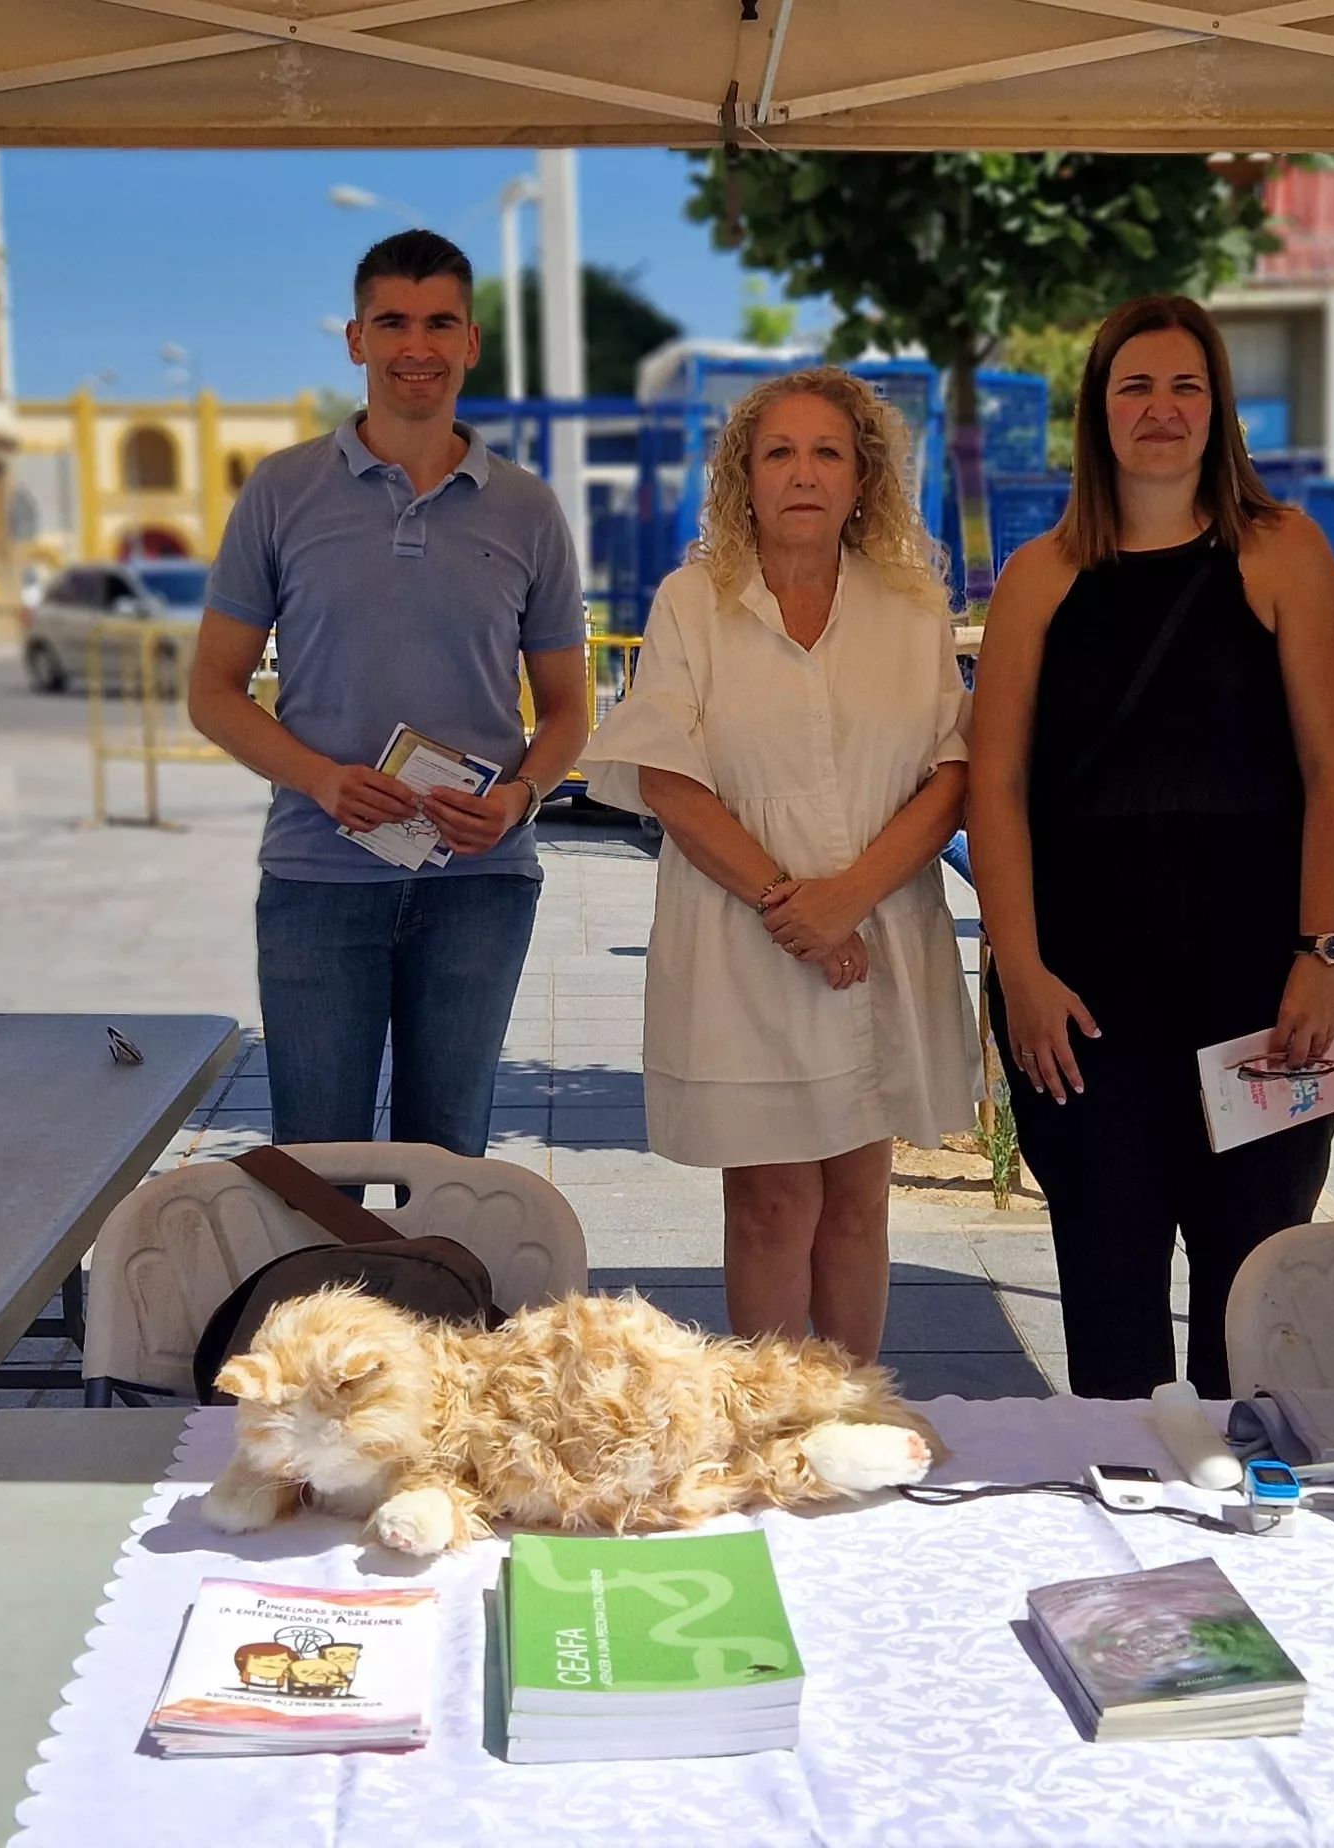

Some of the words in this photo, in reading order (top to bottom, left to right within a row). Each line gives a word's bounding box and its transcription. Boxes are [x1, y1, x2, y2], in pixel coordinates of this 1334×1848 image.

[236, 1608, 312, 1623] ENFERMEDAD
[316, 1617, 330, 1625] DE
[335, 1616, 403, 1626] ALZHEIMER
[257, 1599, 327, 1615] PINCELADAS
[331, 1609, 371, 1617] SOBRE
[556, 1628, 591, 1685] CEAFA
